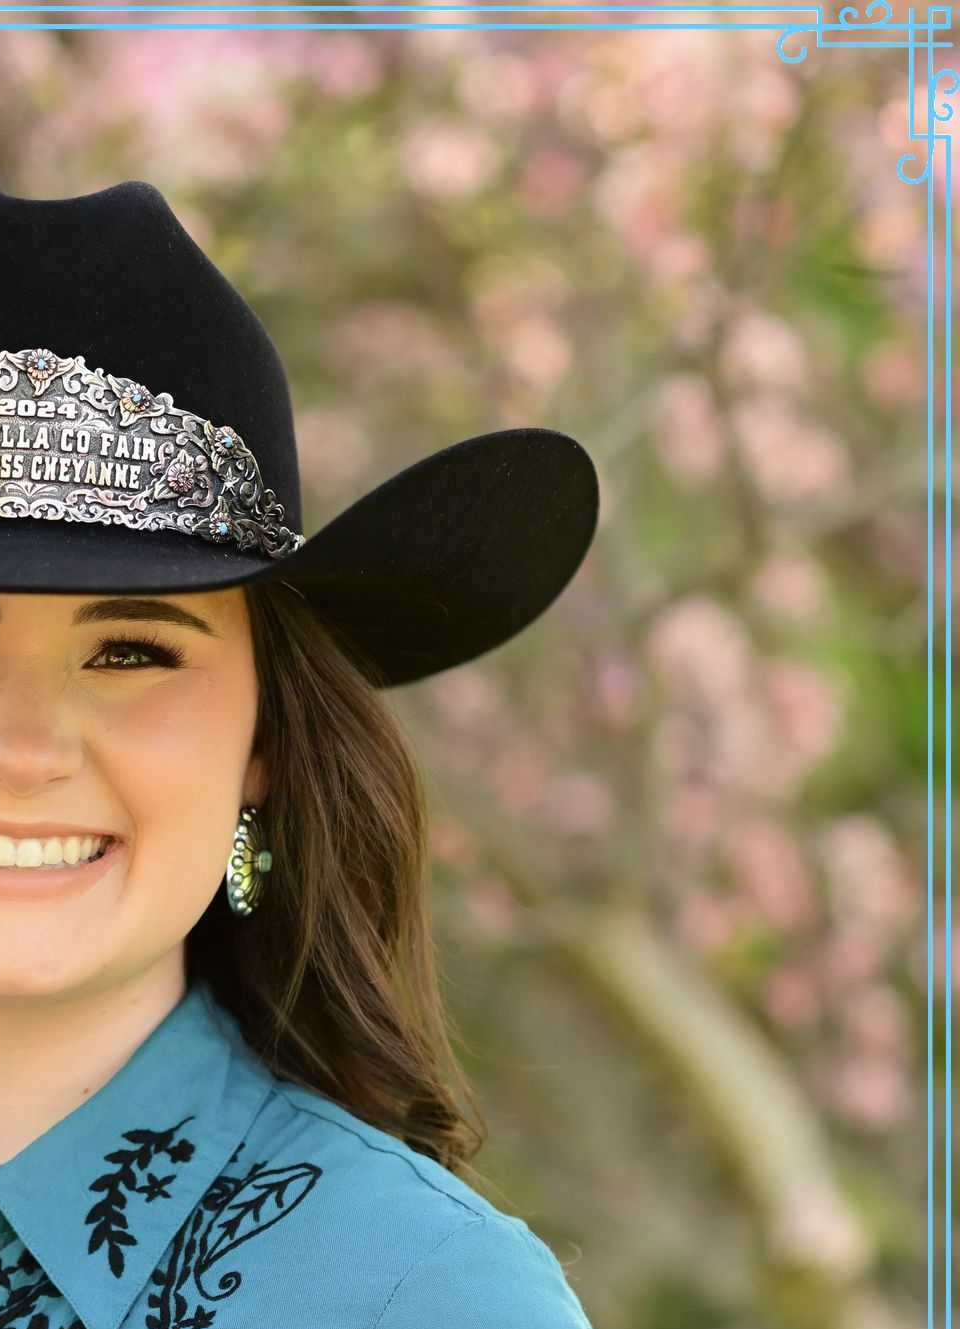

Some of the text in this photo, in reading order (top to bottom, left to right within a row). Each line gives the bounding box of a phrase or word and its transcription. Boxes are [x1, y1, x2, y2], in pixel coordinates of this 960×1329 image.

[59, 428, 91, 454] CO
[99, 435, 157, 463] FAIR
[30, 455, 141, 489] CHEYANNE
